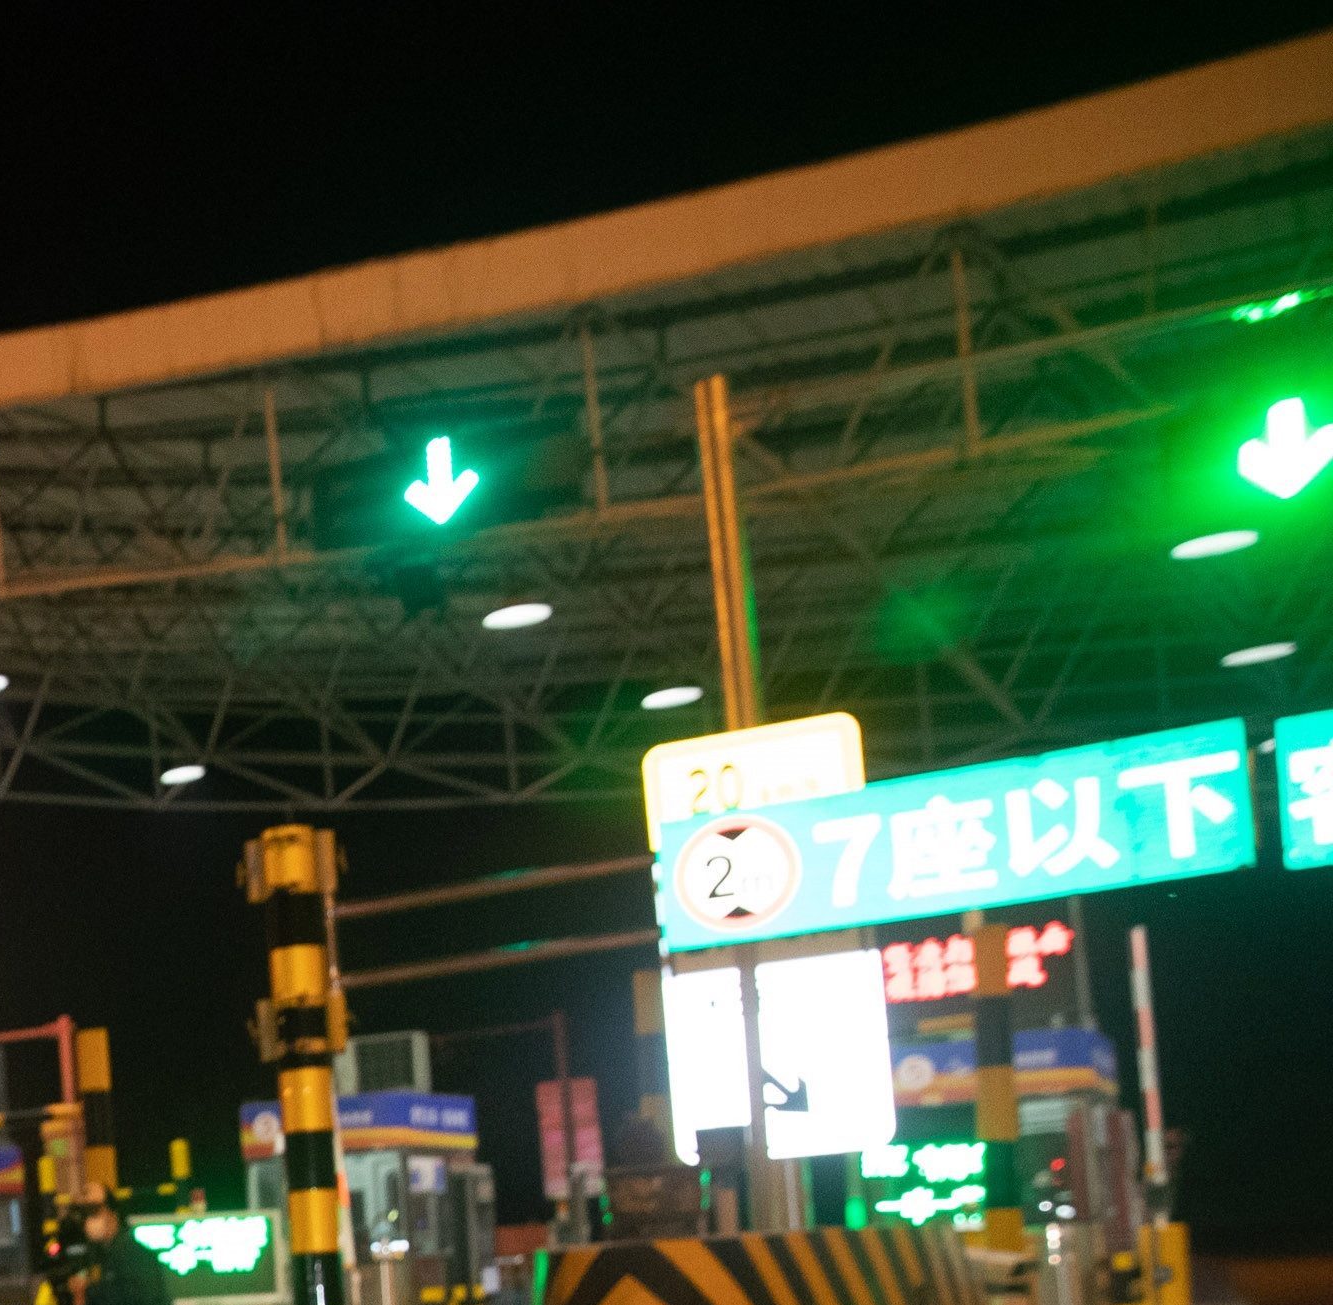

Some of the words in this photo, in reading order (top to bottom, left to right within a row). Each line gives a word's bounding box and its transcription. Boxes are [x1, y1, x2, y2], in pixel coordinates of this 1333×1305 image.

[687, 762, 744, 816] 20
[811, 749, 1241, 909] 7座以下
